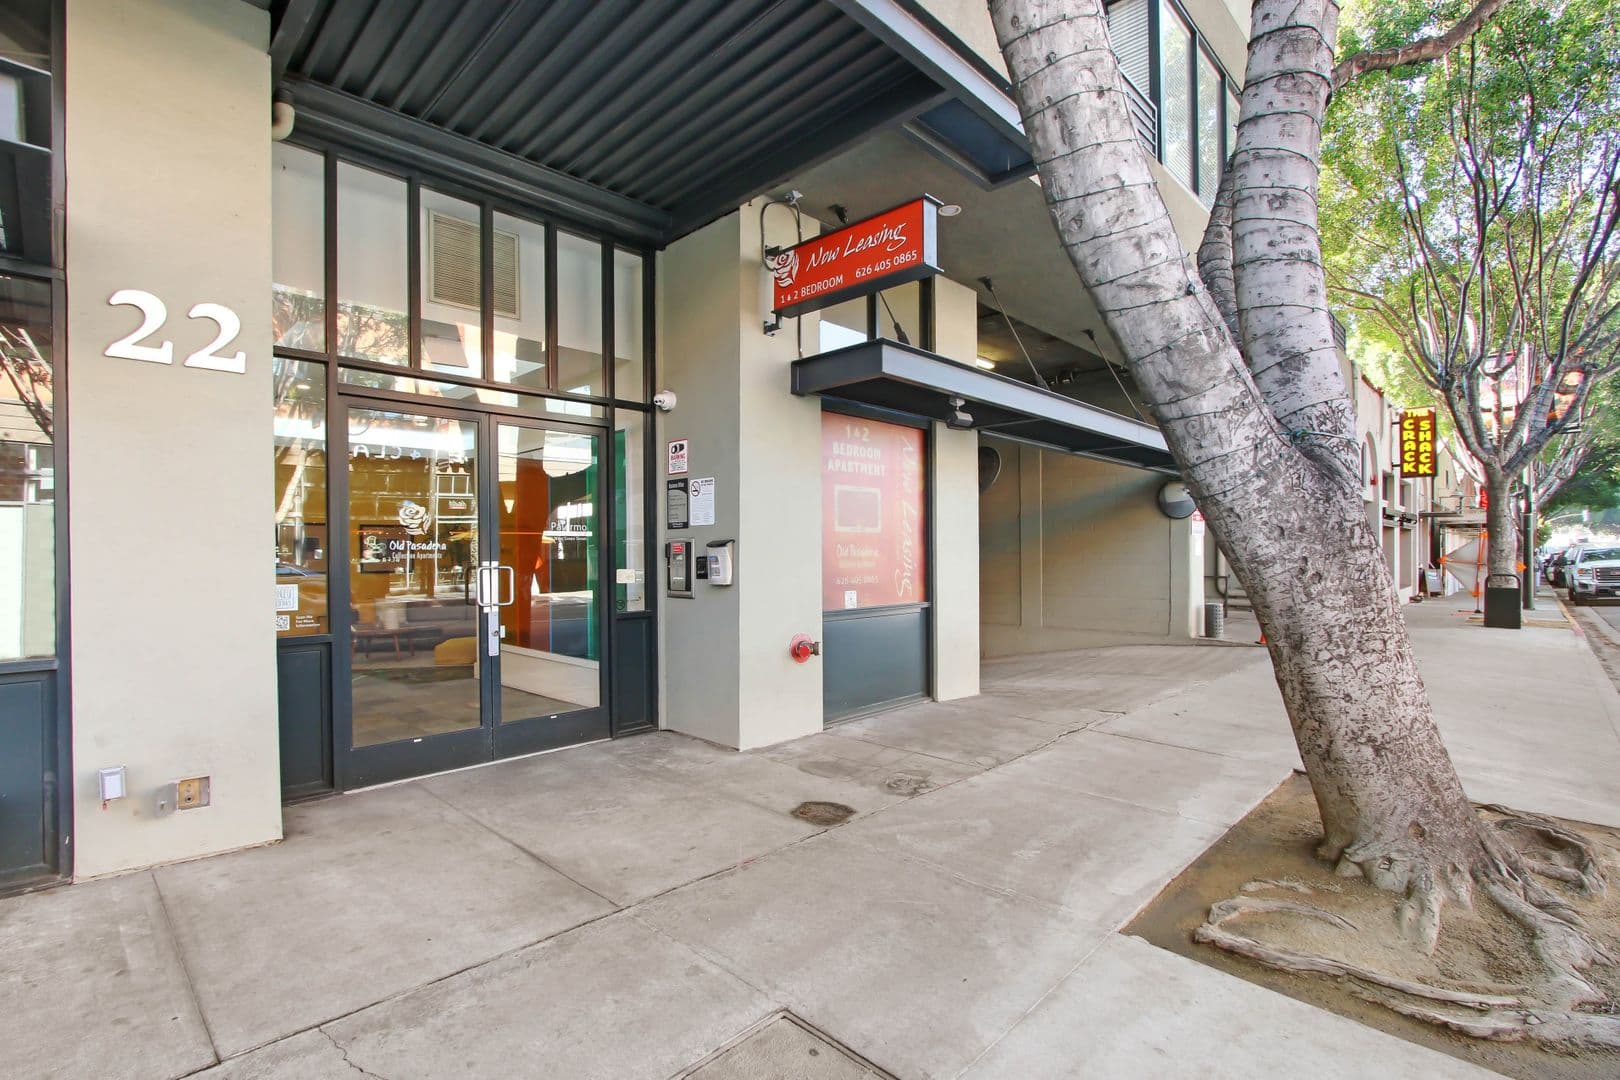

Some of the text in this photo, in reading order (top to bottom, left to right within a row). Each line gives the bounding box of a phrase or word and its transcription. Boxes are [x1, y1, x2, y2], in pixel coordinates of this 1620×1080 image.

[806, 222, 907, 272] Now Leasing
[855, 250, 918, 278] 626 405 0865
[801, 274, 843, 297] BEDROOM
[104, 288, 248, 375] 22
[832, 441, 882, 460] BEDROOM
[1402, 418, 1417, 473] CRACK
[1418, 420, 1433, 475] SHACK
[827, 458, 887, 477] APARTMENT
[389, 540, 447, 551] Old Pasadena
